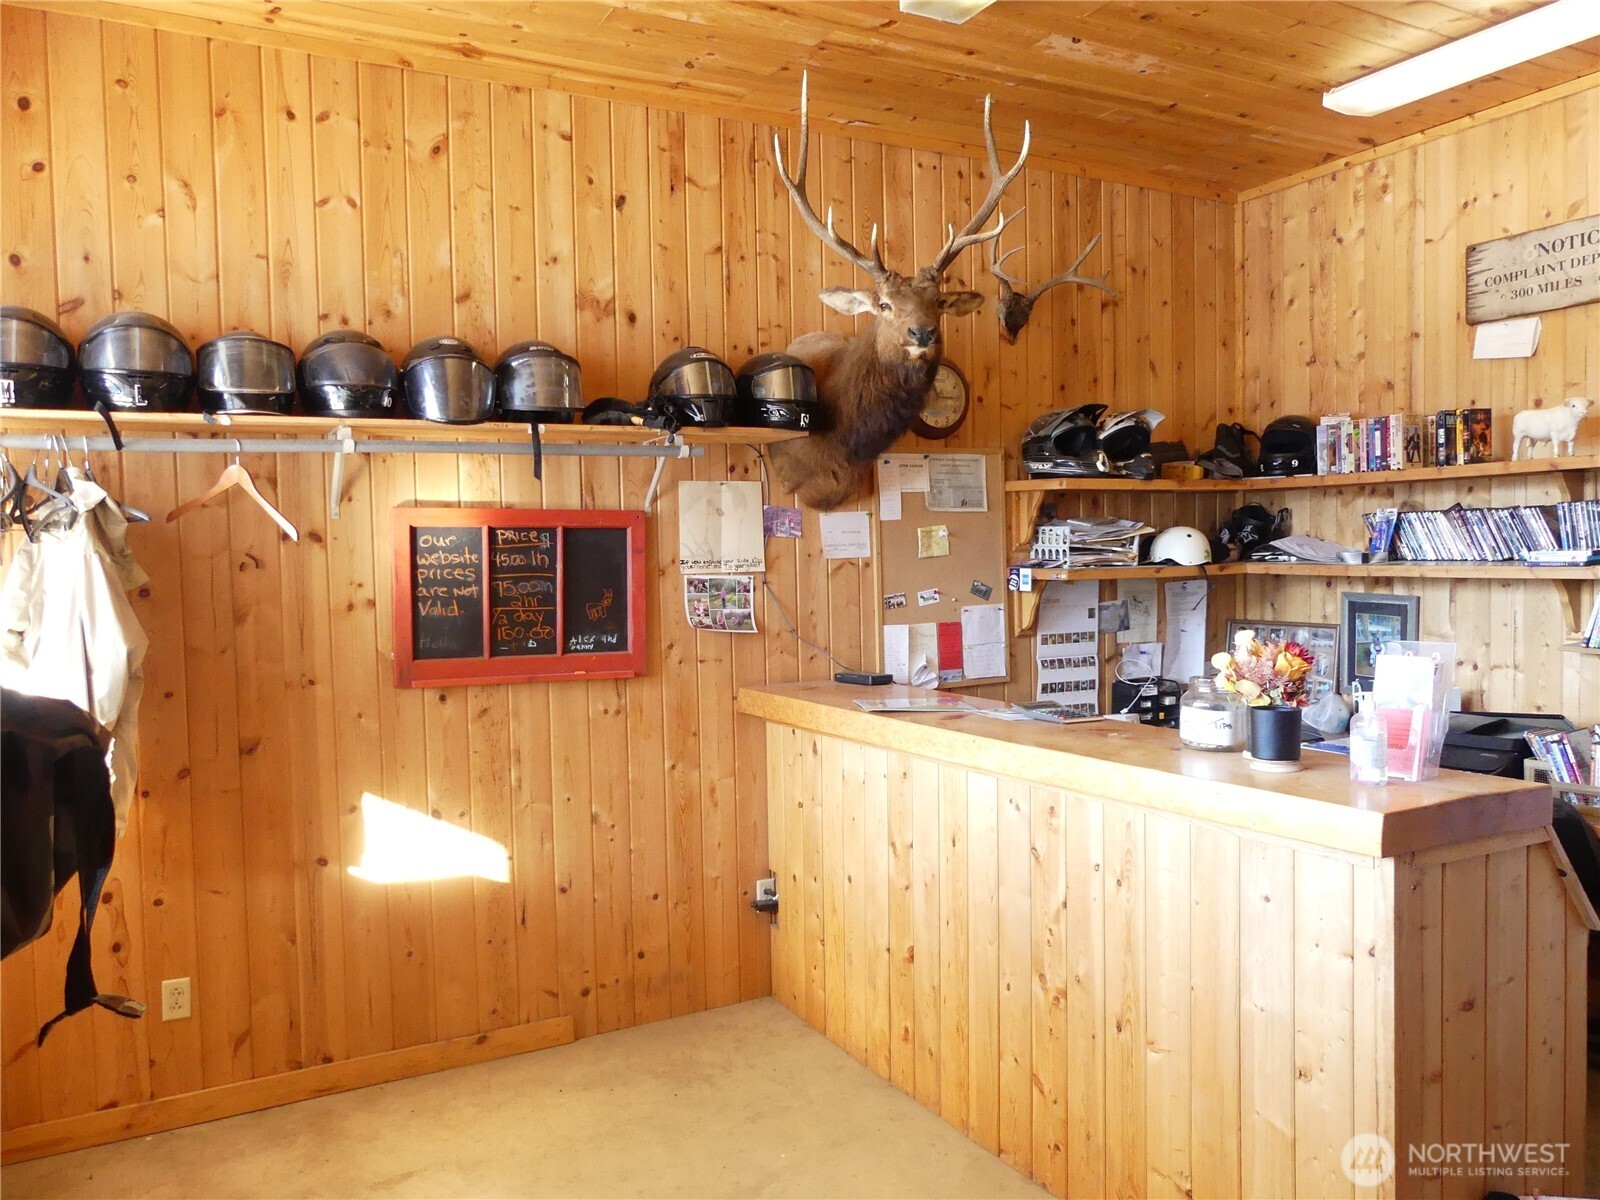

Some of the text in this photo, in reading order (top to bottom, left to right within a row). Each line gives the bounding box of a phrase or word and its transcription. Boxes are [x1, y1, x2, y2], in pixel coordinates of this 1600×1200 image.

[1484, 260, 1566, 288] COMPLAINT
[1510, 275, 1583, 300] 300 MILES
[1291, 459, 1299, 468] 9
[419, 534, 457, 548] Our
[416, 546, 480, 567] website
[416, 567, 477, 584] prices
[415, 585, 450, 598] are
